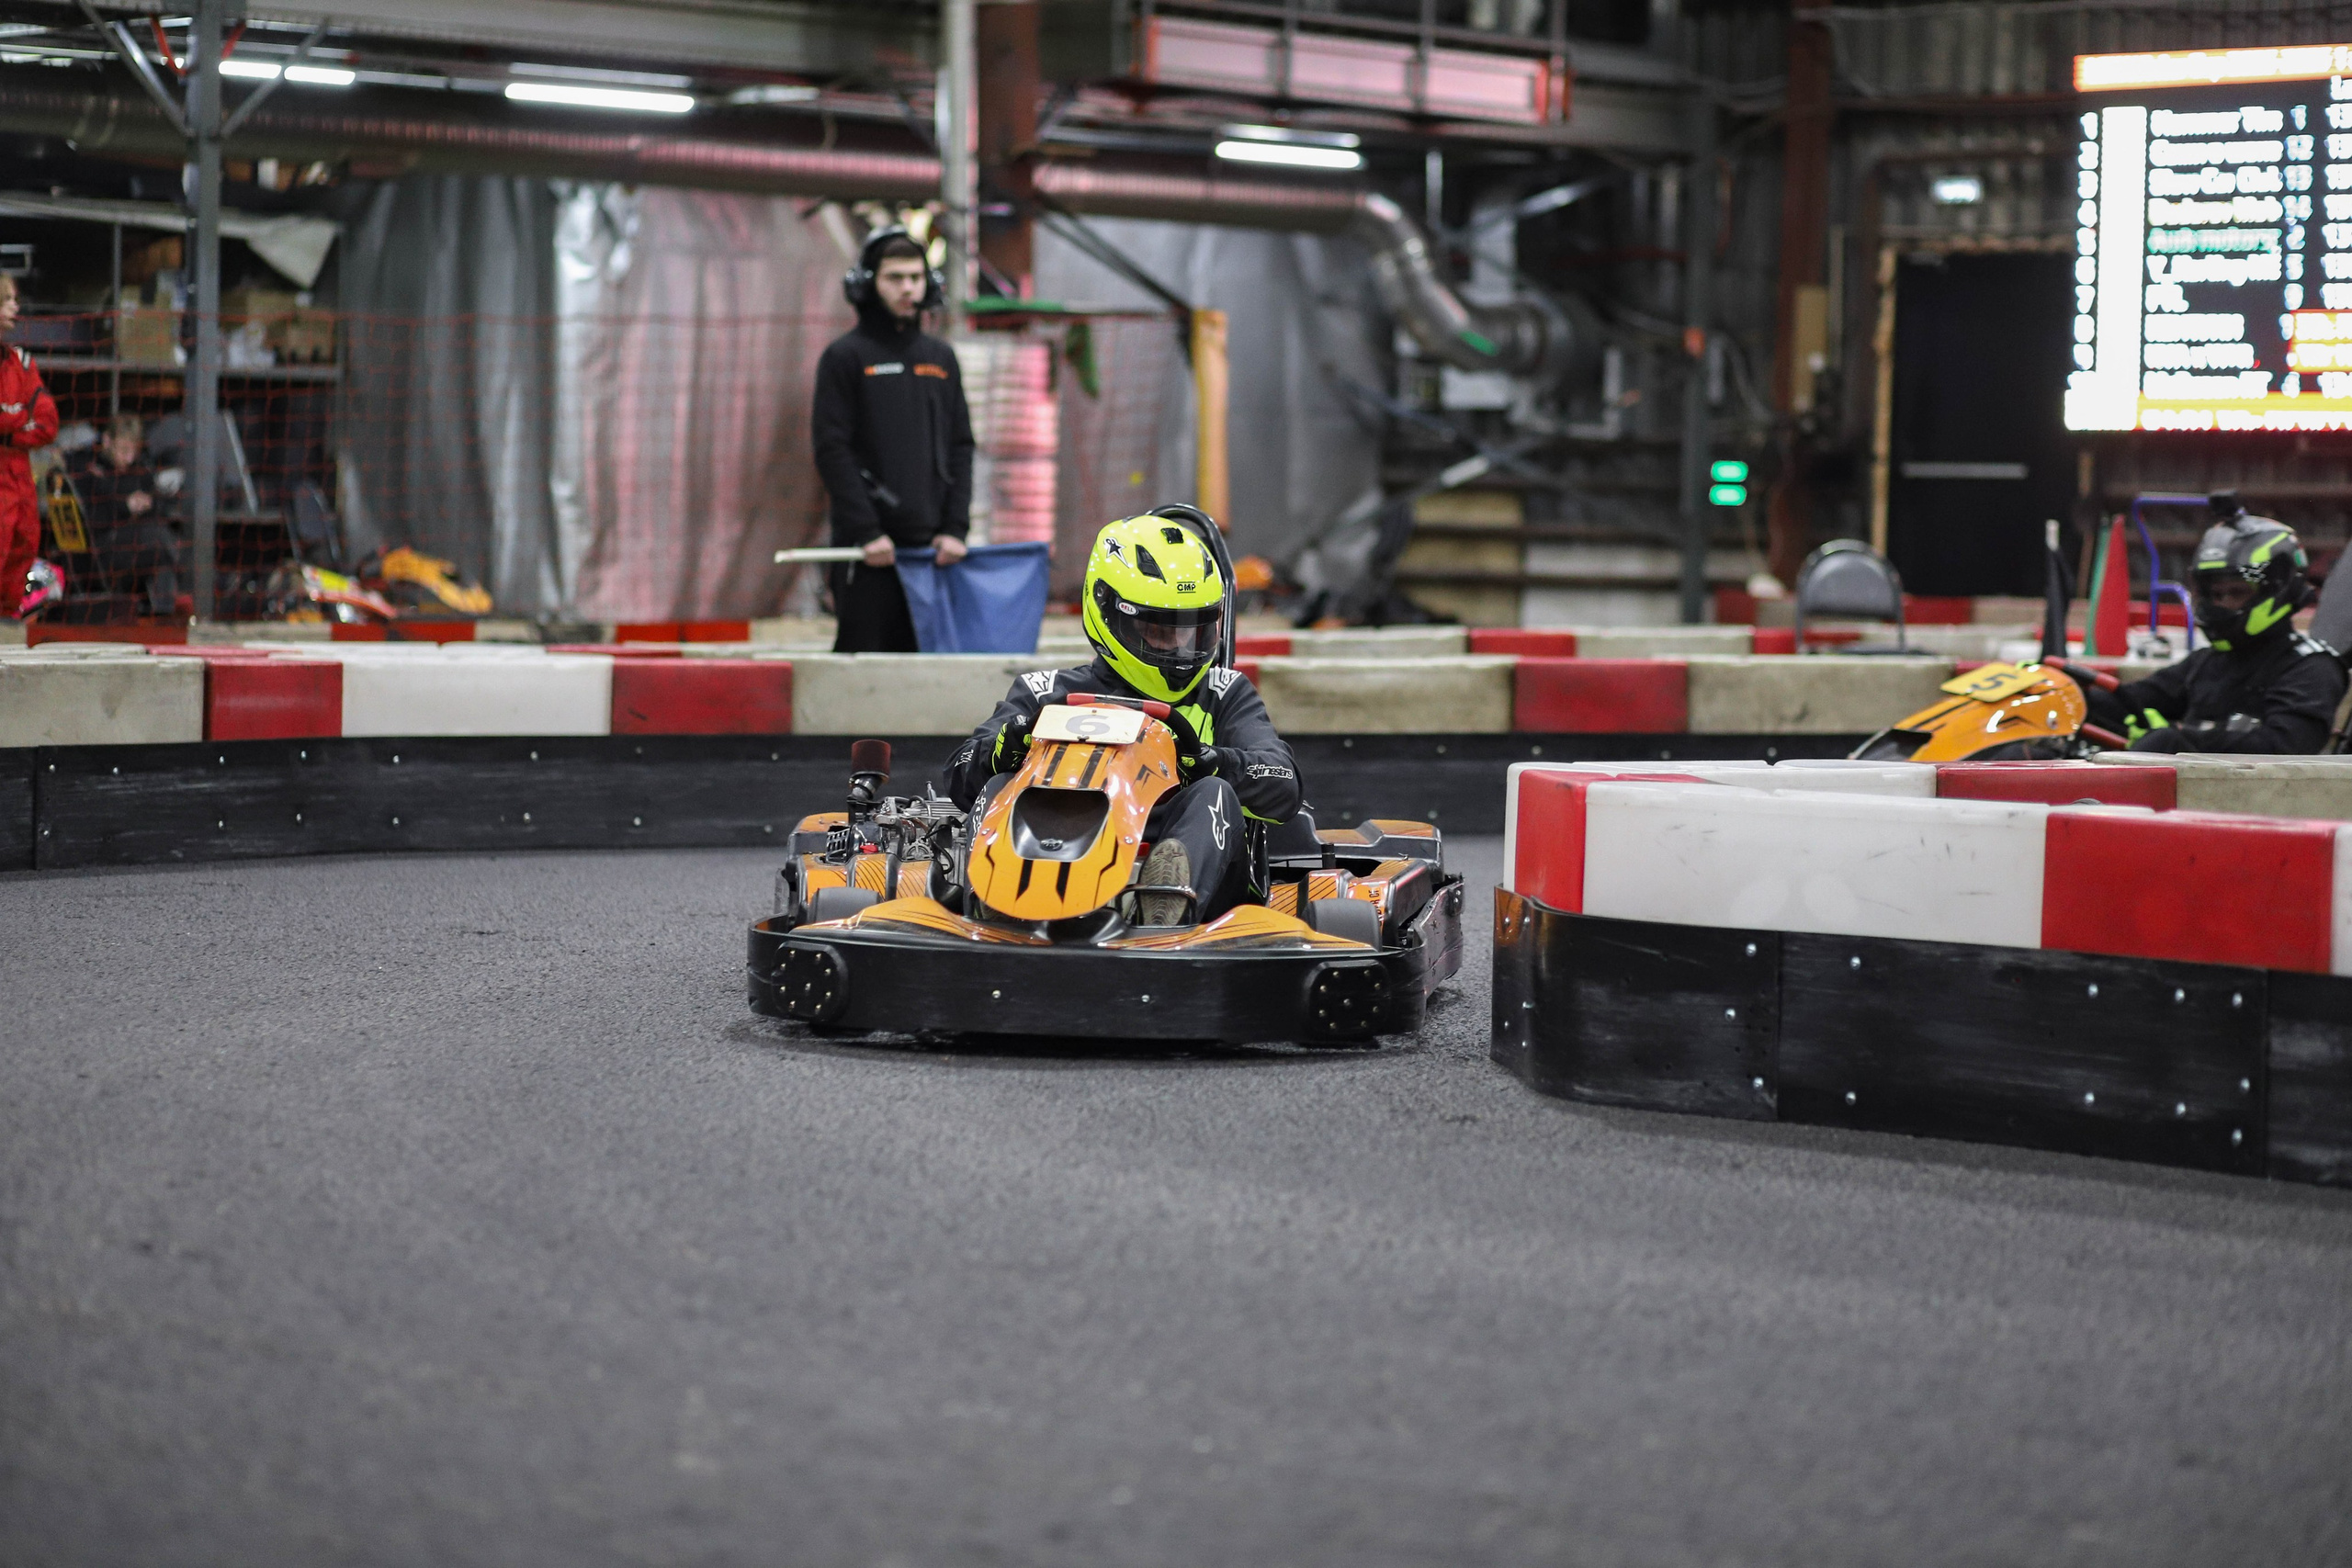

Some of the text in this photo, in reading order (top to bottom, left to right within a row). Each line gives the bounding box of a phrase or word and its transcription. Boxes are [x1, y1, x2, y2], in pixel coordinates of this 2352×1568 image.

[1120, 604, 1134, 613] BELL
[1971, 672, 2018, 691] 5
[1065, 714, 1111, 736] 6
